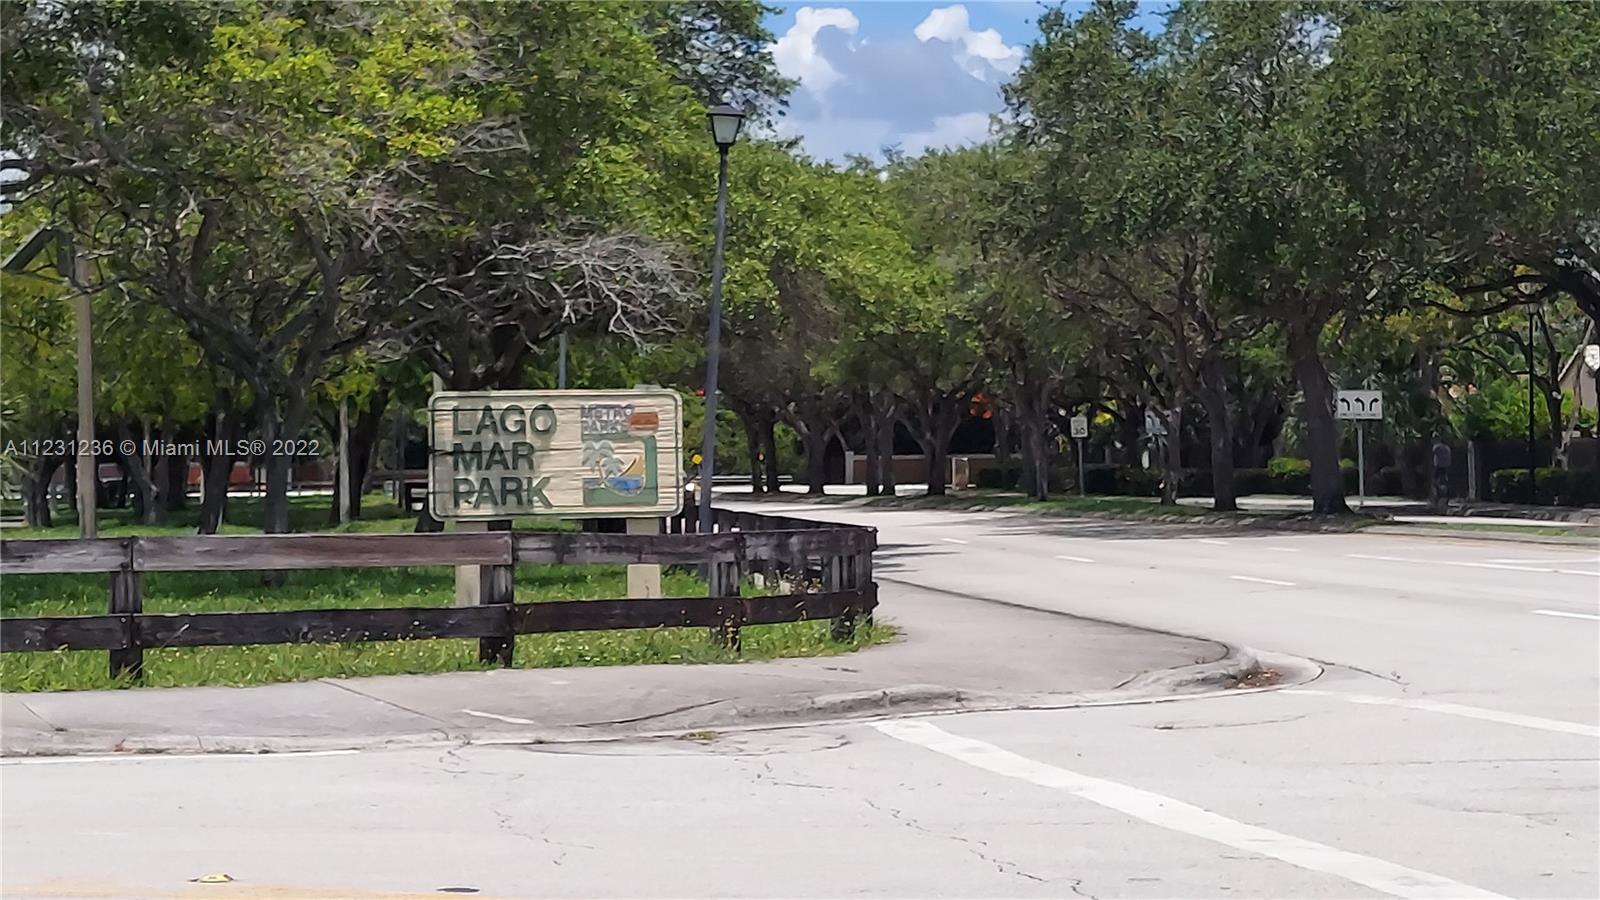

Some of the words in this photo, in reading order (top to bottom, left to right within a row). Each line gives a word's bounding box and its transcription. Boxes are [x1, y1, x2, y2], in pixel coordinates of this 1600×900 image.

[452, 403, 557, 436] LAGO
[580, 404, 634, 420] METRO
[452, 441, 535, 472] MAR
[452, 476, 553, 509] PARK
